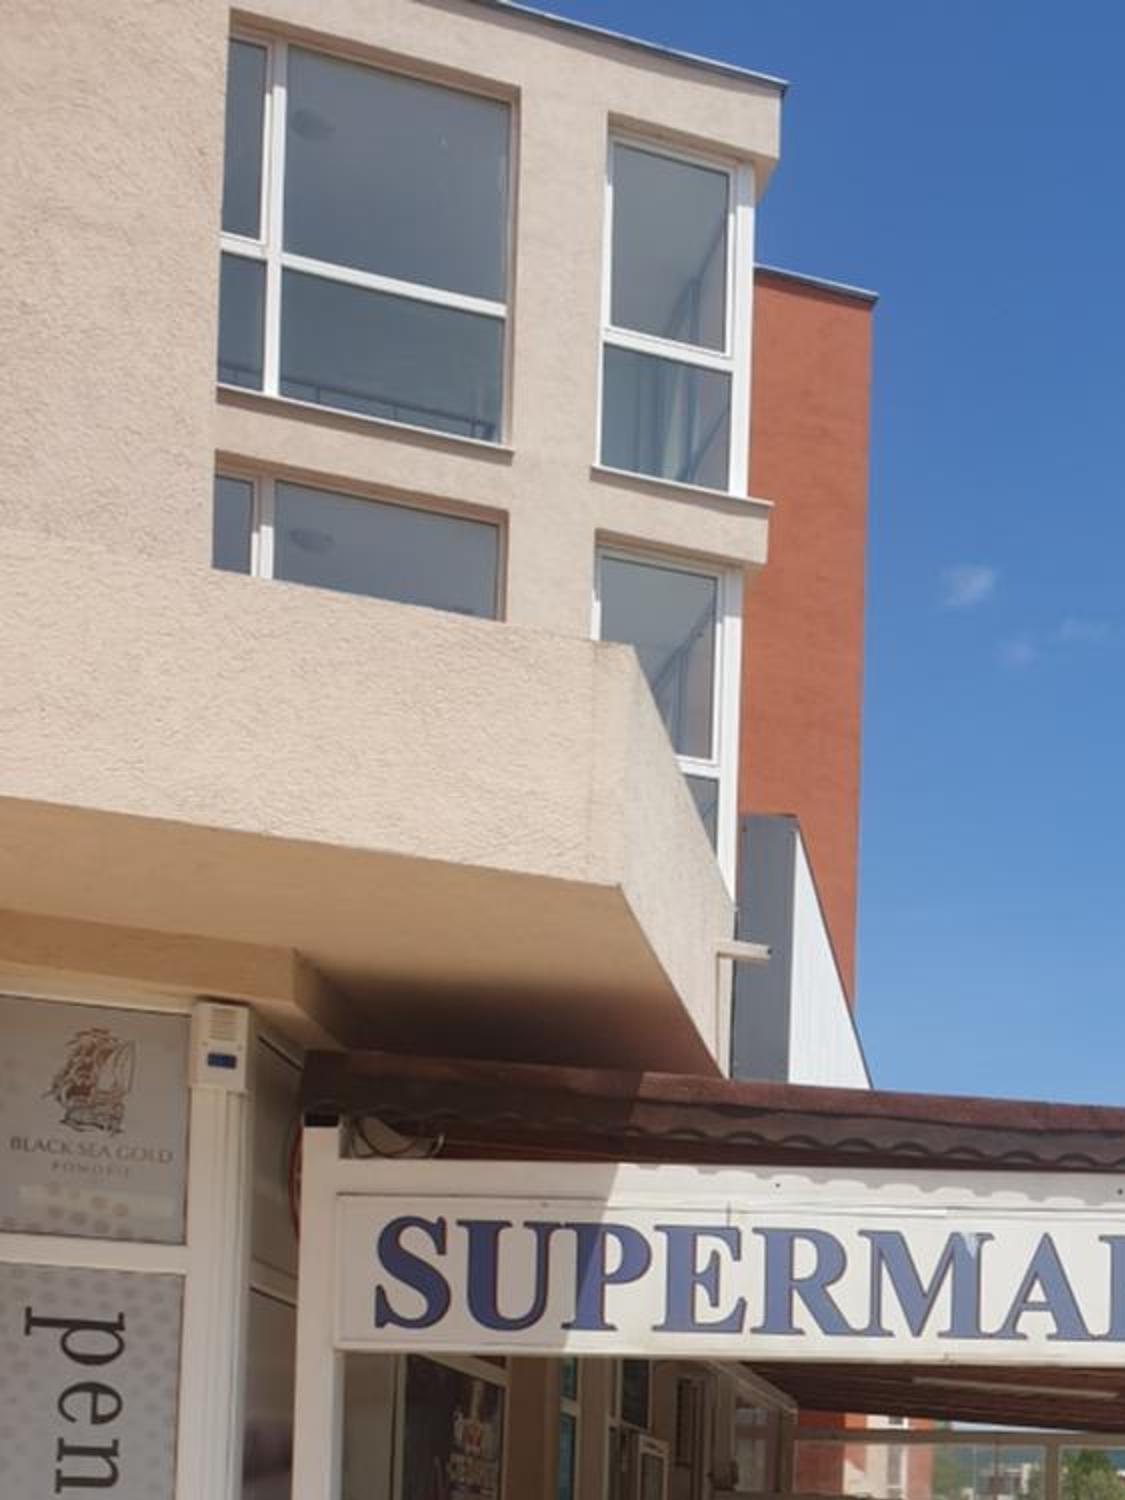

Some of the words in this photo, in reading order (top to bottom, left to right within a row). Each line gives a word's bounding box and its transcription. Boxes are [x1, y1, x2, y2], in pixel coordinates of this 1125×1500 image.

[10, 1136, 72, 1155] BLACK
[77, 1142, 111, 1159] SEA
[115, 1146, 174, 1164] GOLD
